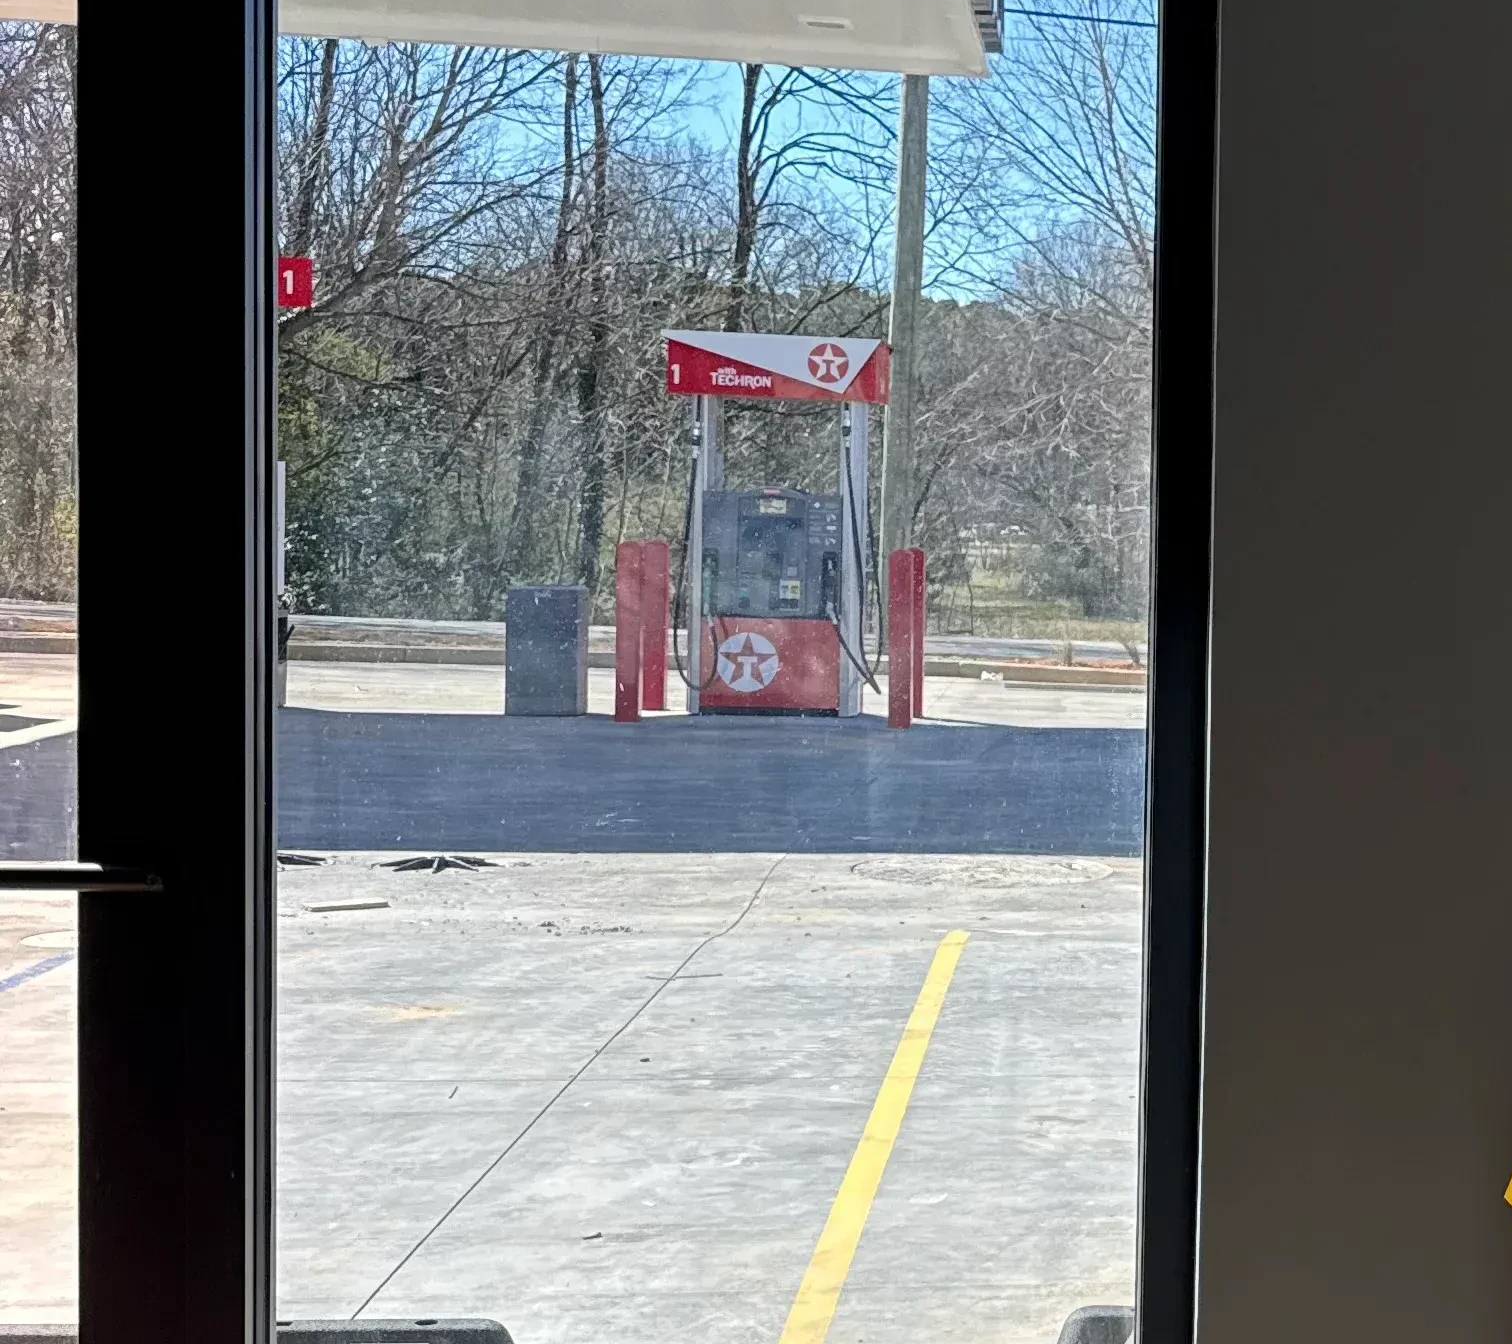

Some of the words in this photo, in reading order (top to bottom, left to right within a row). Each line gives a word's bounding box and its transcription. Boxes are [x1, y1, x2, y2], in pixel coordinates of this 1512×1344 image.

[282, 269, 294, 295] 1
[670, 363, 680, 385] 1
[709, 371, 772, 389] TECHRON
[717, 366, 736, 375] with
